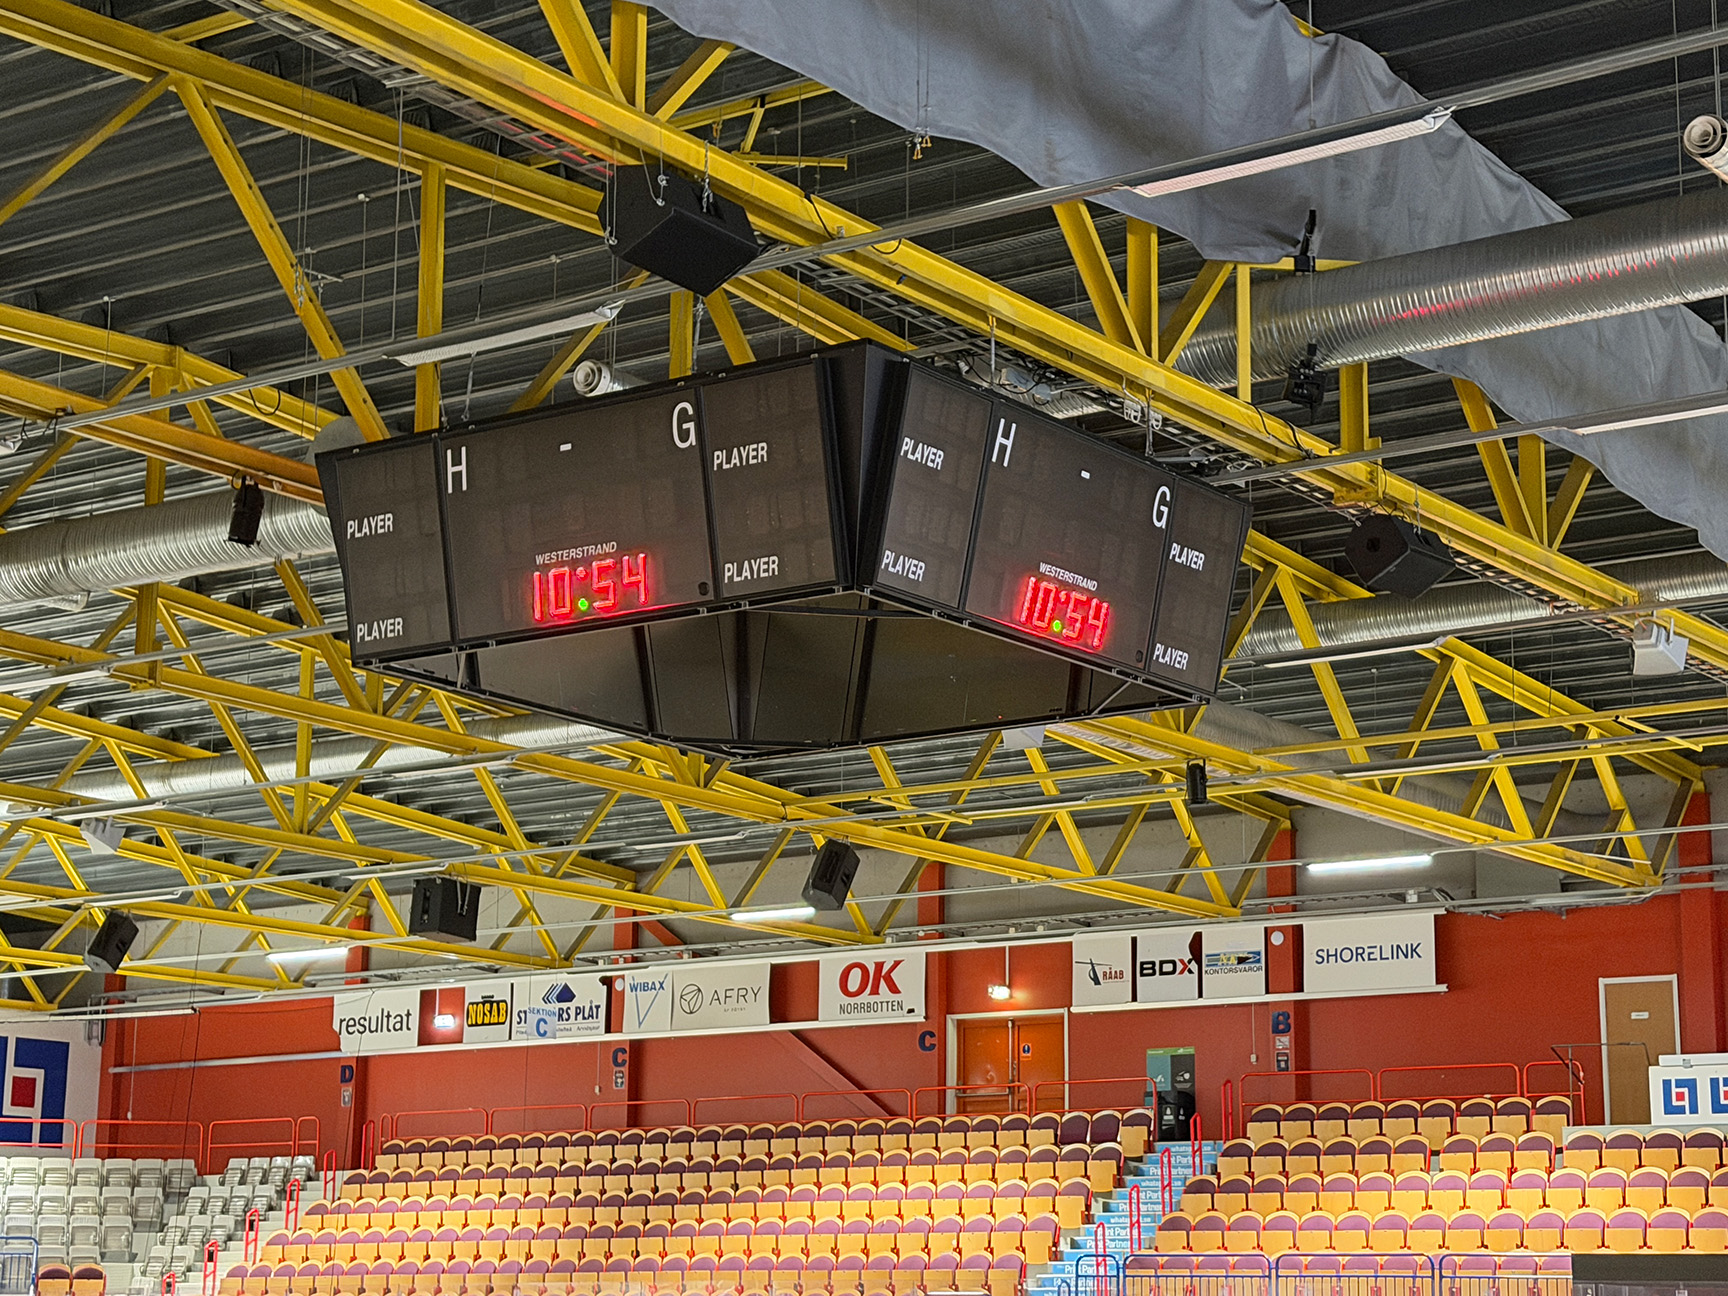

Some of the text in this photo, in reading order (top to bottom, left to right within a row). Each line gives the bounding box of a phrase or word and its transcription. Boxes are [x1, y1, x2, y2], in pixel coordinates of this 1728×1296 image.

[447, 447, 467, 494] H
[672, 402, 697, 449] G
[713, 443, 768, 470] PLAYER
[900, 436, 945, 470] PLAYER
[991, 418, 1017, 467] H
[1152, 486, 1171, 529] G
[347, 513, 394, 539] PLAYER
[535, 541, 617, 565] WESTERSTRAND
[1169, 542, 1205, 571] PLAYER
[724, 556, 779, 584] PLAYER
[881, 550, 926, 582] PLAYER
[1039, 562, 1098, 591] WESTERSTRAND
[532, 553, 650, 622] 10:54
[1019, 576, 1110, 649] 10:54
[356, 618, 403, 642] PLAYER
[1152, 643, 1189, 671] PLAYER
[1315, 942, 1422, 965] SHORELINK
[839, 959, 905, 998] OK
[1102, 967, 1125, 981] RÅAB
[1139, 958, 1194, 978] BDX
[1205, 965, 1263, 975] KONTORSVAROR
[629, 980, 665, 993] WIBAX
[709, 986, 762, 1006] AFRY
[467, 1002, 507, 1025] NOSAB
[527, 1006, 557, 1018] SEKTION
[574, 1000, 601, 1022] PLÅT
[839, 1000, 904, 1015] NORRBOTTEN
[338, 1008, 412, 1036] resultat
[535, 1017, 548, 1038] C
[1271, 1011, 1292, 1034] B
[918, 1030, 937, 1052] C
[612, 1047, 628, 1067] C
[340, 1064, 355, 1084] D
